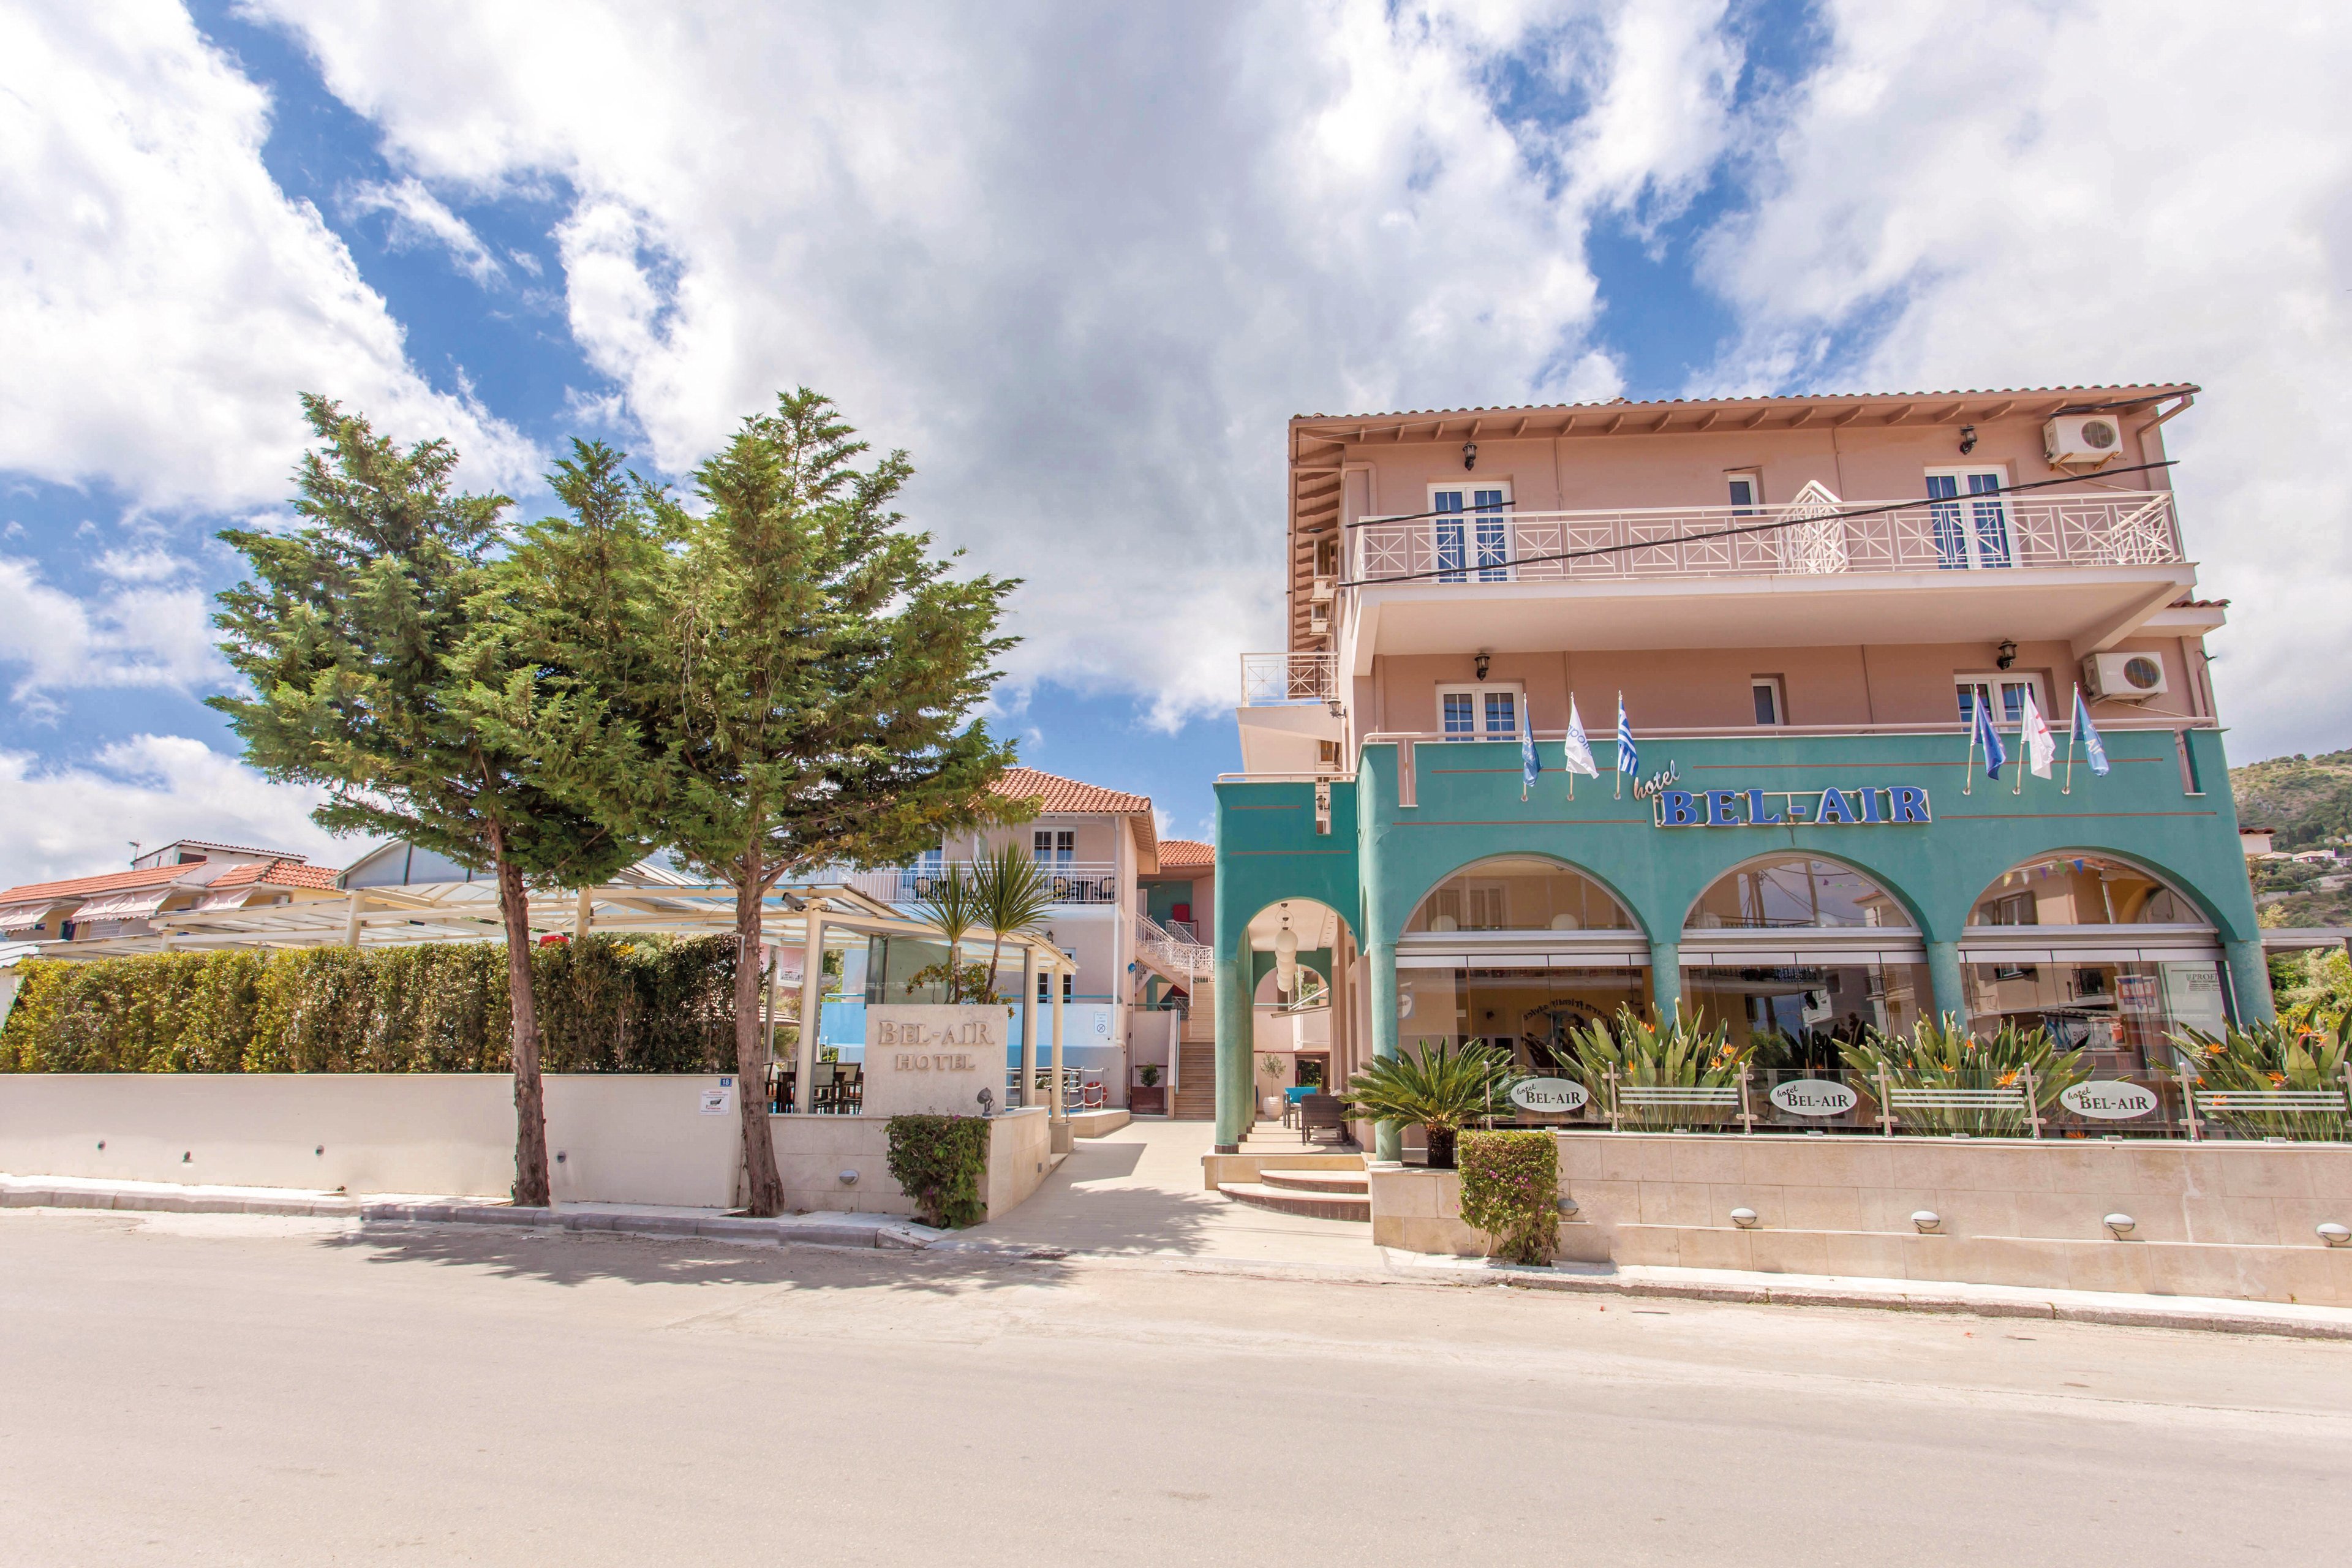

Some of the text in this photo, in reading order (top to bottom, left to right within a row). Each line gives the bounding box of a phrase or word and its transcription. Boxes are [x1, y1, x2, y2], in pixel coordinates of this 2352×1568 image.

[1634, 759, 1681, 801] hotel
[1659, 786, 1932, 827] BEL-AIR
[878, 1020, 995, 1045] BEL-AIR
[895, 1054, 976, 1071] HOTEL
[1517, 1083, 1536, 1095] hotel
[1777, 1085, 1798, 1097] hotel
[2067, 1086, 2092, 1100] hotel
[1526, 1091, 1582, 1104] BEL-AIR
[1787, 1093, 1850, 1107] BEL-AIR
[2080, 1096, 2149, 1109] BEL-AIR
